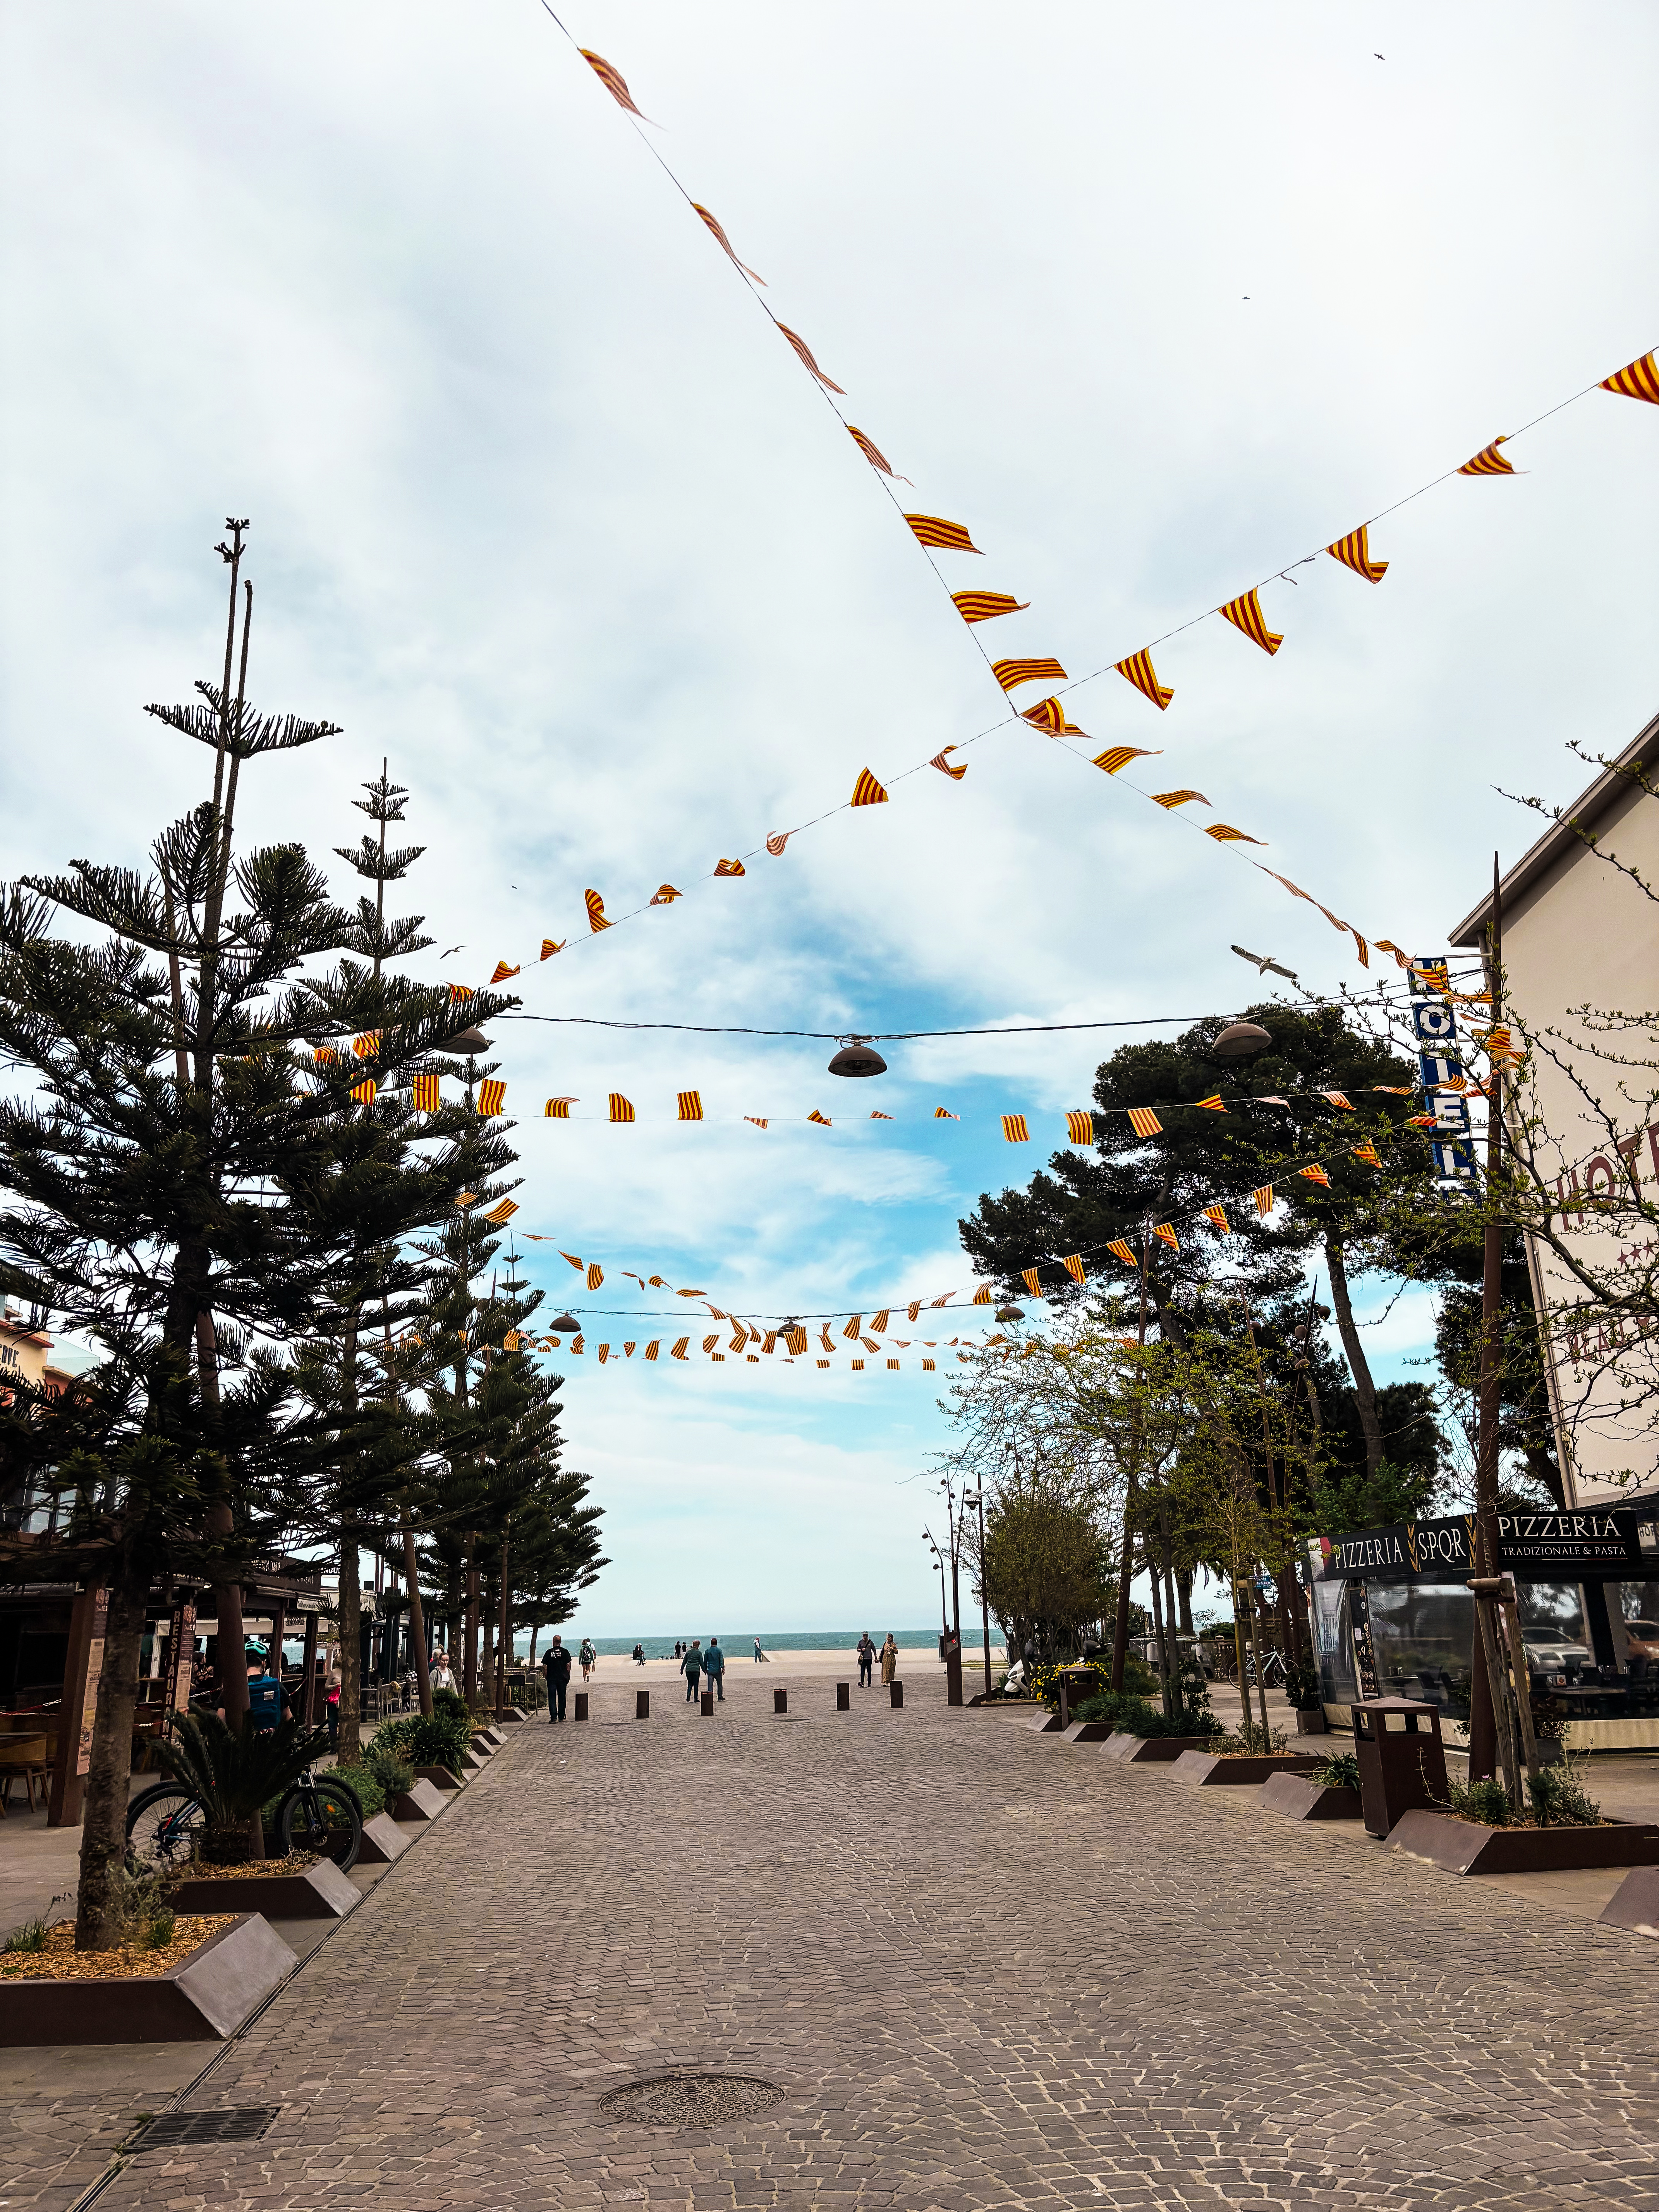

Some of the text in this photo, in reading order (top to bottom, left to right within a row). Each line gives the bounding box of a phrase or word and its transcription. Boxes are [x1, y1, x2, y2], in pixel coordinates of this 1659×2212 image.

[1556, 1121, 1659, 1232] HOT
[1498, 1516, 1621, 1537] PIZZERIA
[1336, 1537, 1404, 1569] PIZZERIA
[1502, 1547, 1580, 1555] TRADIZIONALE
[1595, 1547, 1626, 1555] PASTA
